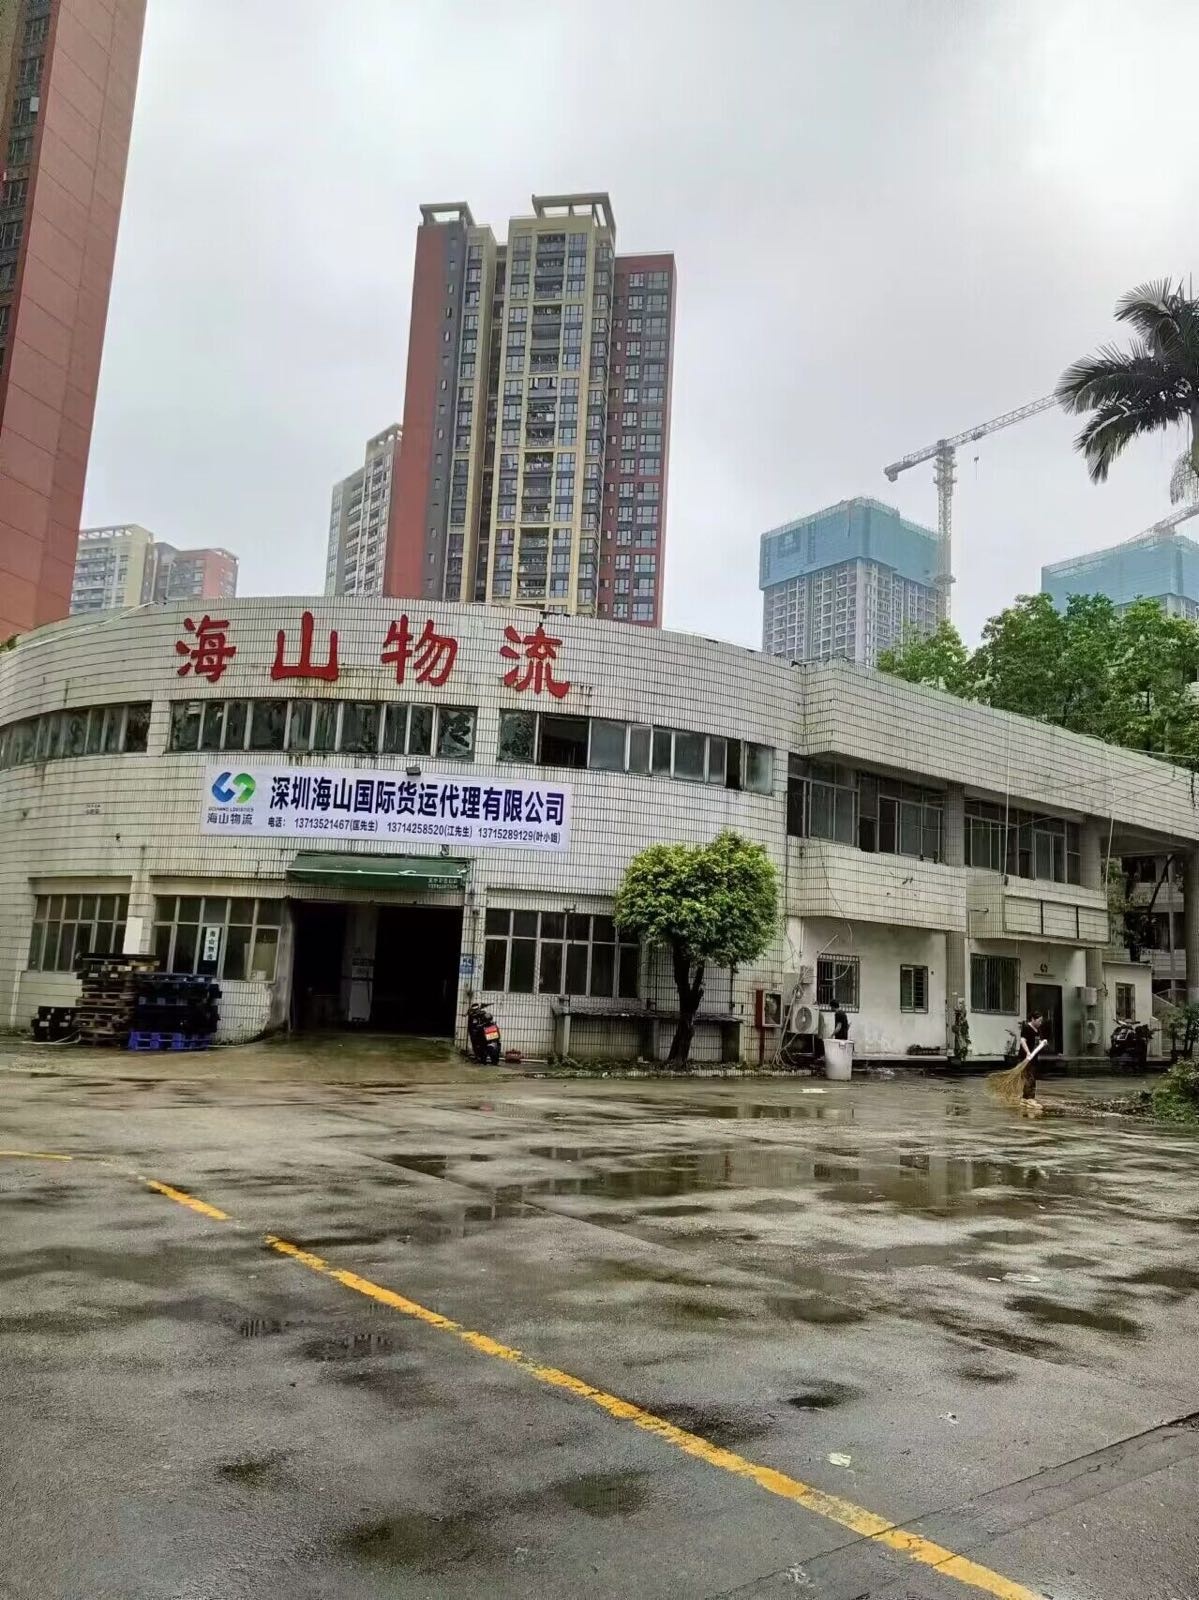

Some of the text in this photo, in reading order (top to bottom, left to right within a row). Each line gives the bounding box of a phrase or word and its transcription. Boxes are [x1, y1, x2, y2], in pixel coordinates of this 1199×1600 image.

[175, 611, 571, 699] 海山物流
[206, 812, 253, 825] 海山物流
[269, 776, 564, 825] 深圳海山国际货运代理有限公司
